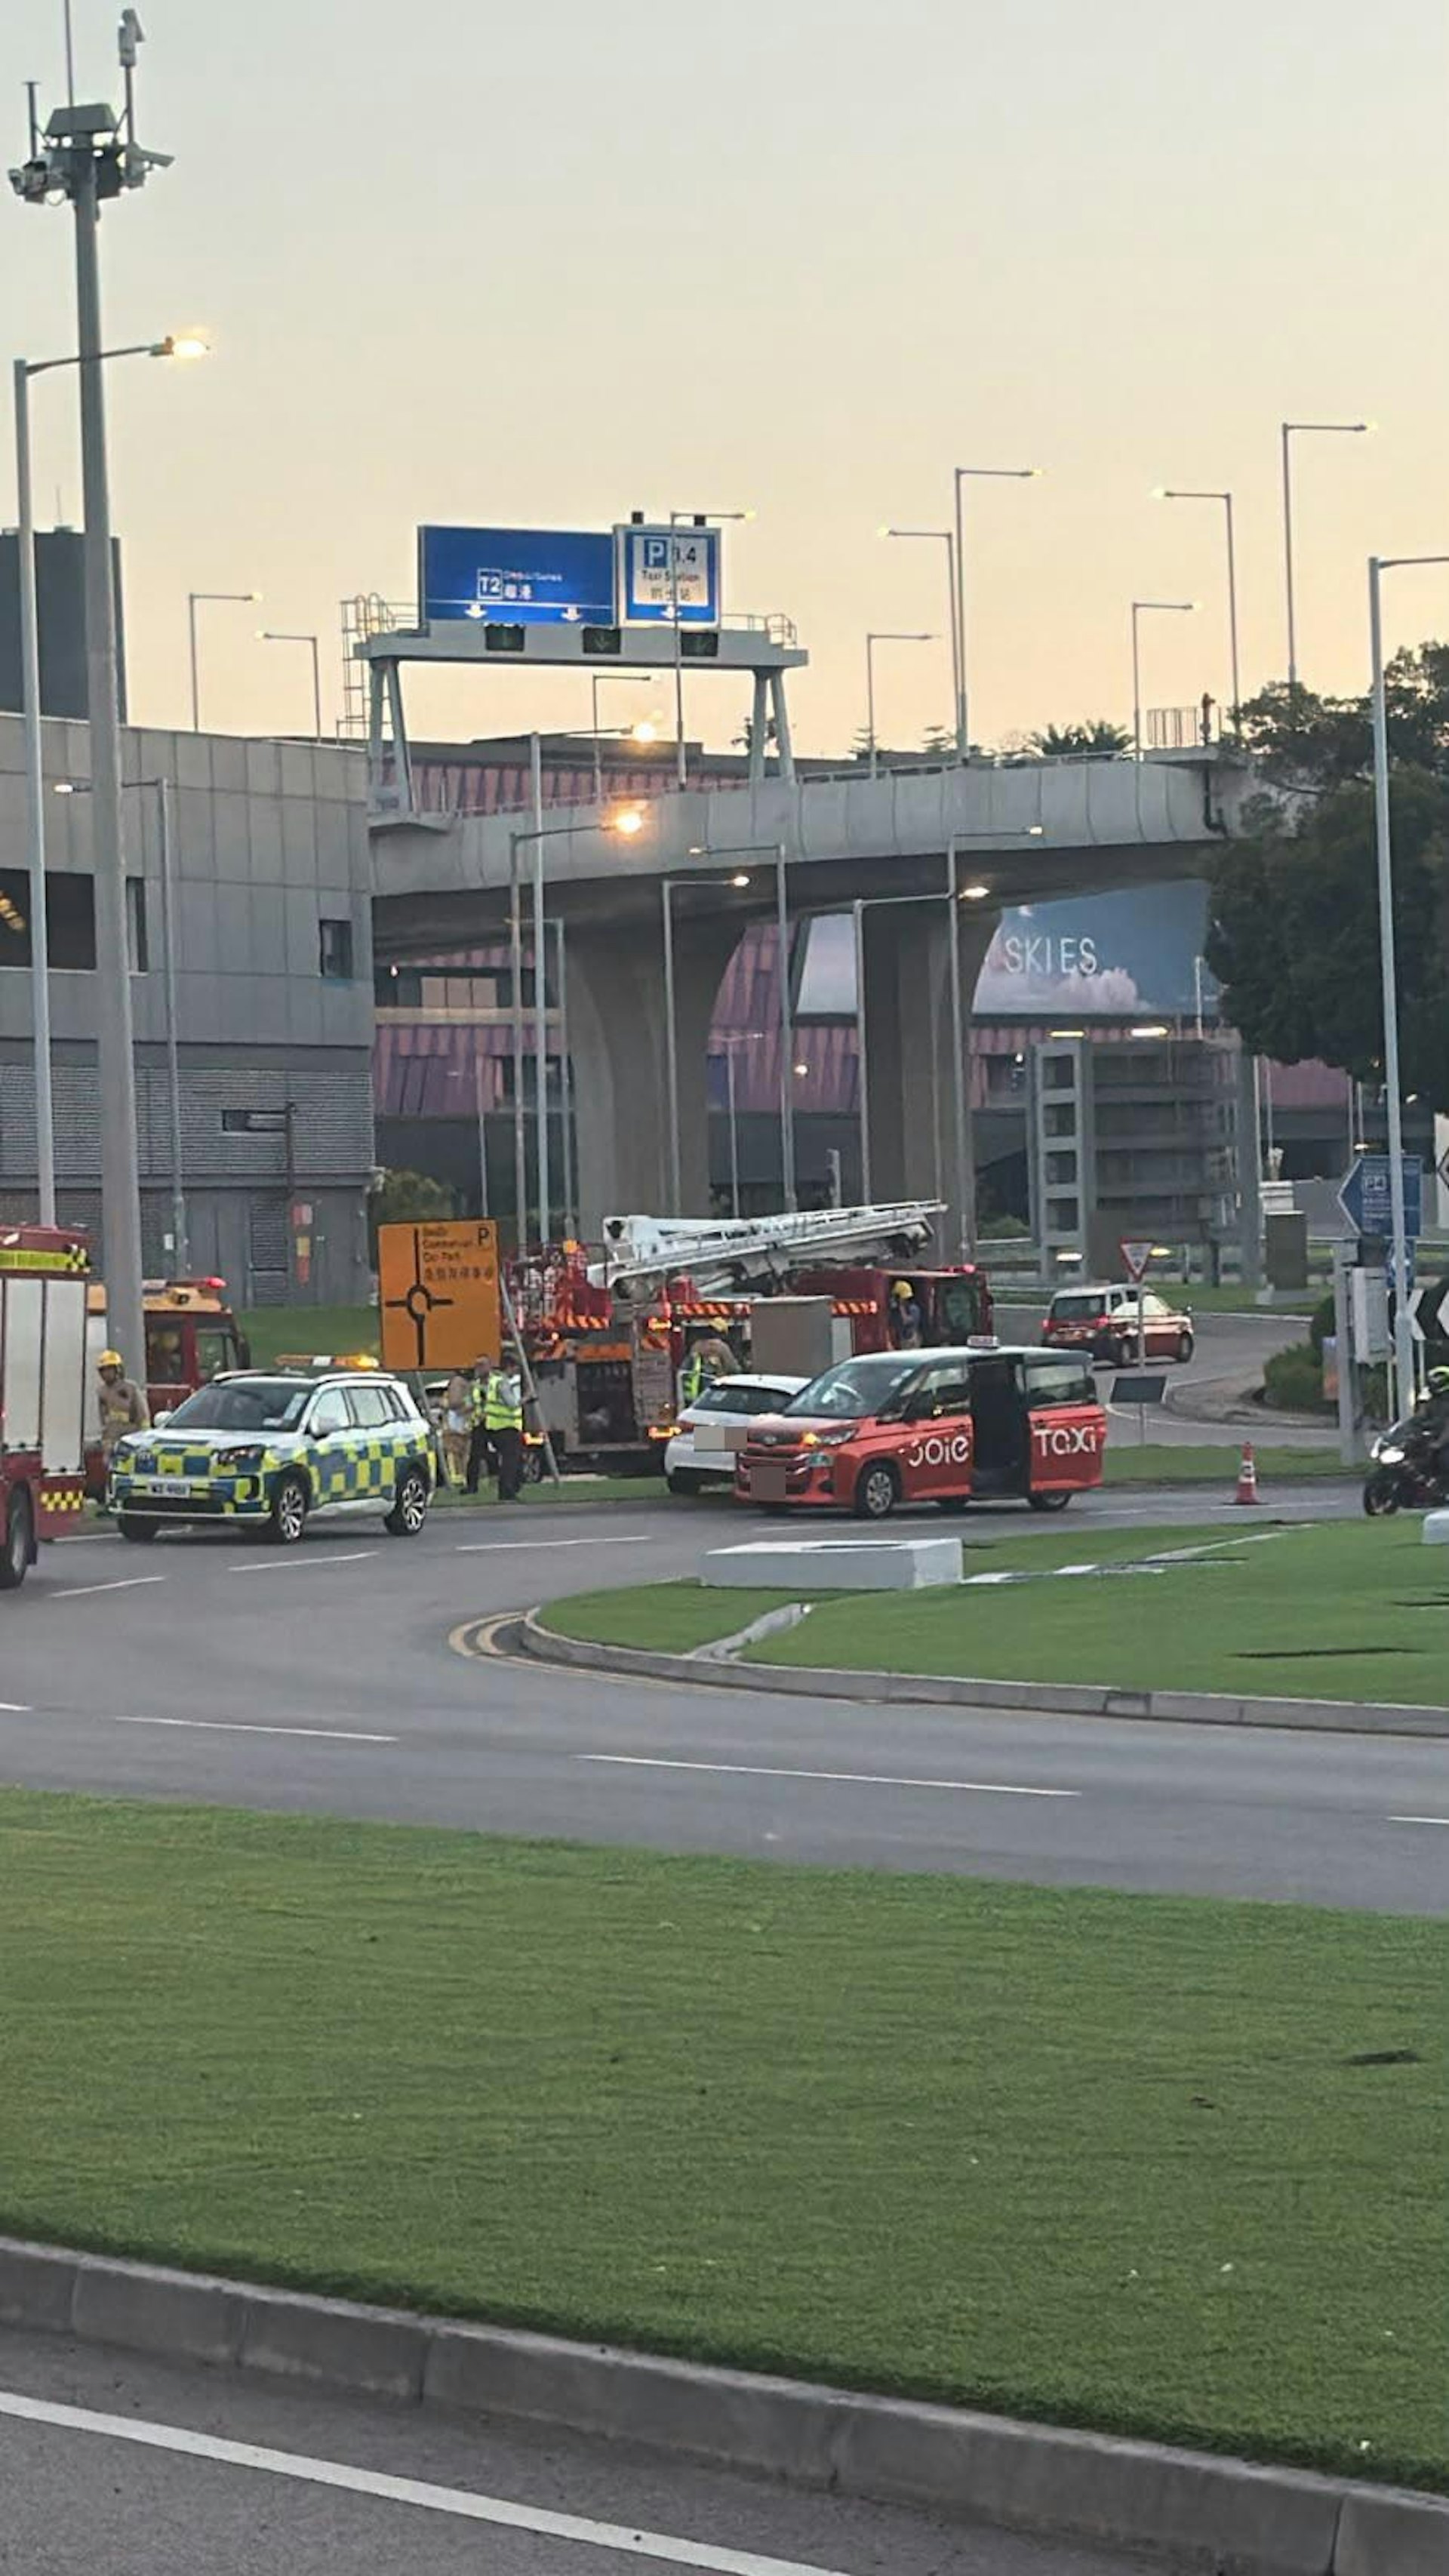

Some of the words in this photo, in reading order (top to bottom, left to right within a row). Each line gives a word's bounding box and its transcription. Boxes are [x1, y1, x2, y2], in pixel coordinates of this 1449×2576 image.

[648, 541, 665, 566] P
[480, 575, 500, 593] T2
[1005, 937, 1097, 975] SKIES
[478, 1227, 489, 1246] P
